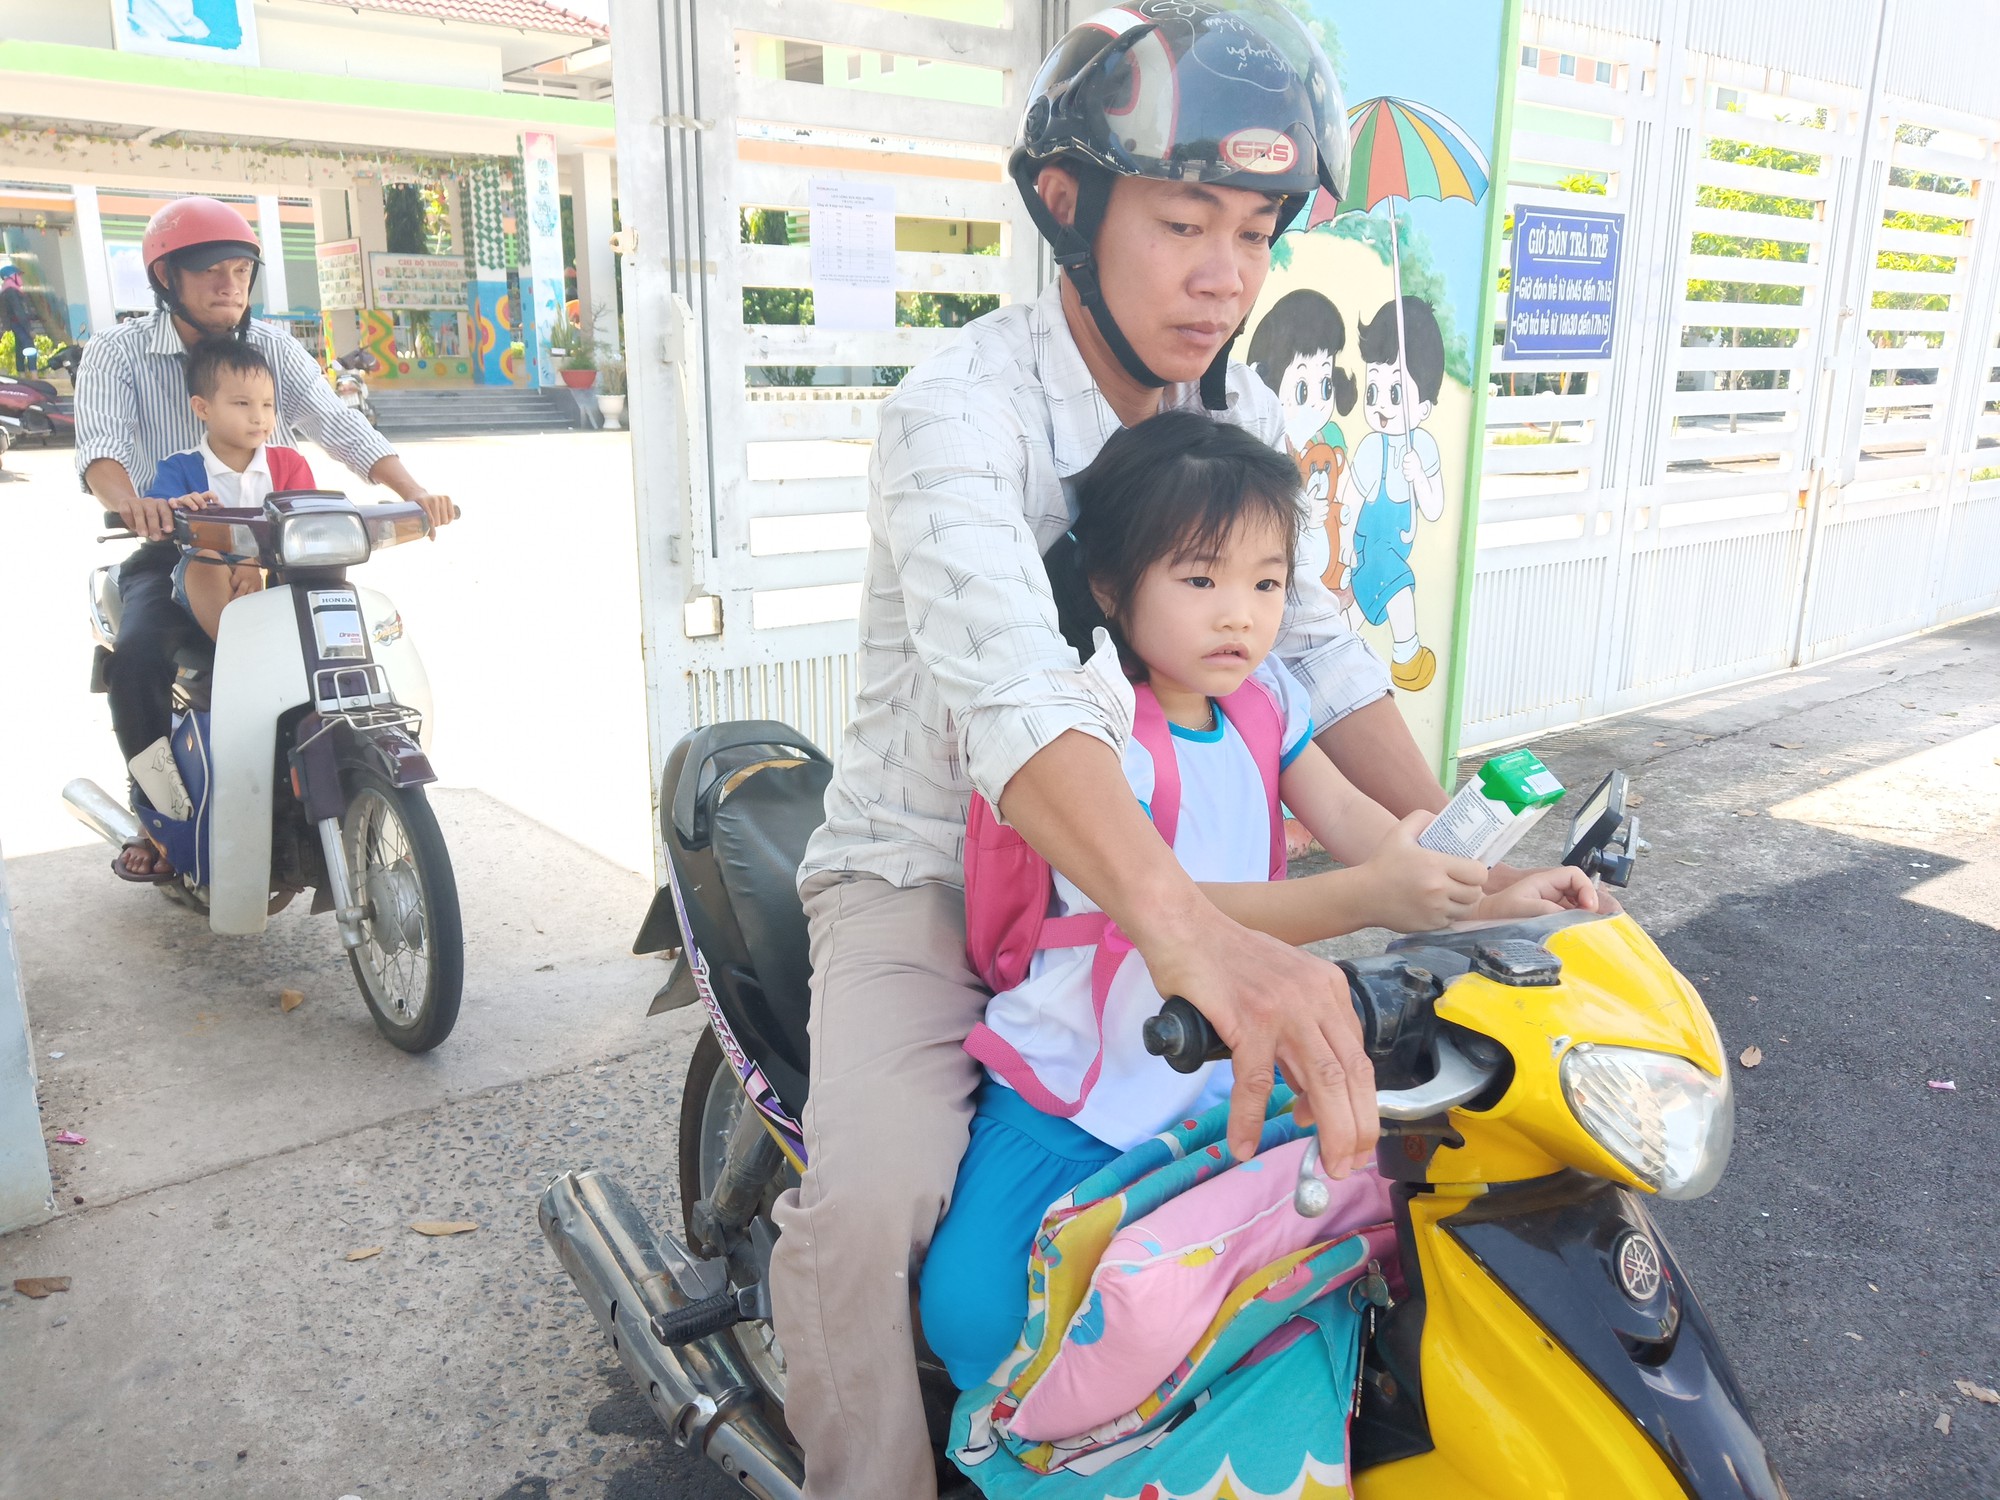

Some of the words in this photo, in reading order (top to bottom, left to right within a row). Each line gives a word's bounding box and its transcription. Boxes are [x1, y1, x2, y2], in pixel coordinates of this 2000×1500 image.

[1231, 140, 1290, 163] GRS
[1528, 222, 1547, 255] GIỜ
[1548, 223, 1568, 256] ĐÓN
[1570, 223, 1588, 258] TRẢ
[1590, 225, 1609, 258] TRẺ
[1532, 276, 1548, 300] đón
[1548, 273, 1558, 301] trẻ
[1558, 277, 1567, 301] từ
[1566, 278, 1583, 301] 6h45
[1582, 277, 1596, 302] đến
[1596, 279, 1613, 303] 7h15
[1529, 309, 1540, 336] trả
[1540, 309, 1551, 336] trẻ
[1550, 312, 1559, 336] từ
[1559, 313, 1578, 336] 16h30
